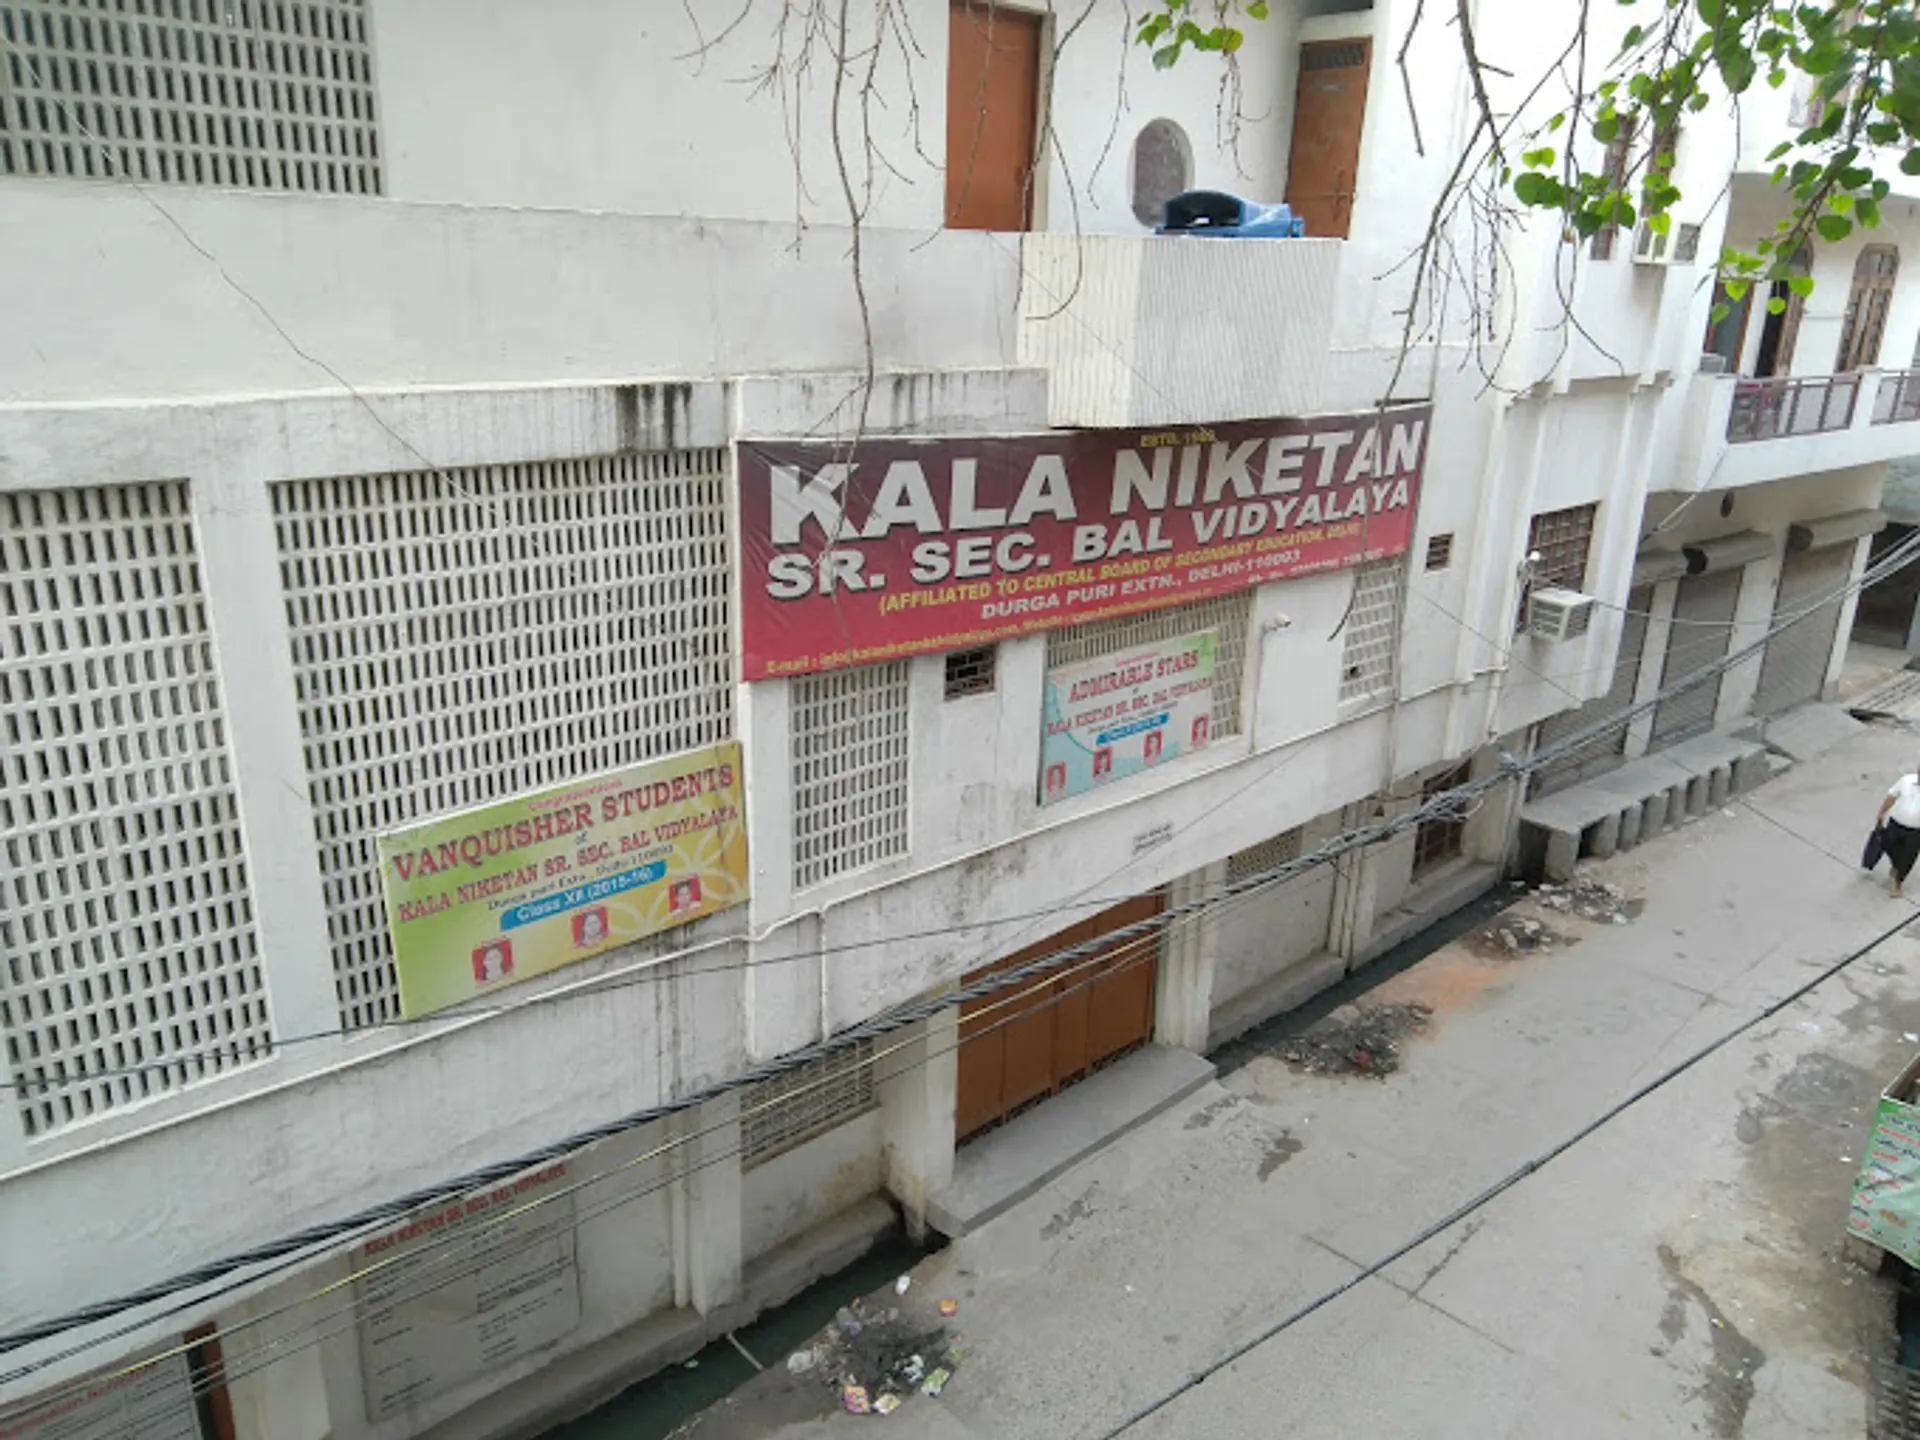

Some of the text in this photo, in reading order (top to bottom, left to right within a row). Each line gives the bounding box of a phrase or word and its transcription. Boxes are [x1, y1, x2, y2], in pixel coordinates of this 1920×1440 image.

[771, 421, 1423, 546] KALA NIKETAN
[766, 480, 1408, 599] SR. SEC. BAL VIDYALAYA
[880, 582, 992, 616] (AFFILIATED
[997, 577, 1019, 597] TO
[1023, 569, 1096, 592] CENTRAL
[1101, 558, 1150, 579] BOARD
[1154, 555, 1173, 571] OF
[1175, 540, 1253, 567] SECONDARY
[981, 593, 1060, 619] DURGA
[1066, 584, 1115, 605] PURI
[1157, 650, 1198, 678] STARS
[393, 763, 734, 882] VANQUISHER STUDENTS
[398, 891, 452, 923] KALA
[457, 864, 538, 904] NIKETAN
[544, 855, 571, 878] SR.
[620, 831, 650, 853] BAL
[654, 805, 738, 842] VIDYALAYA
[516, 898, 561, 923] Class
